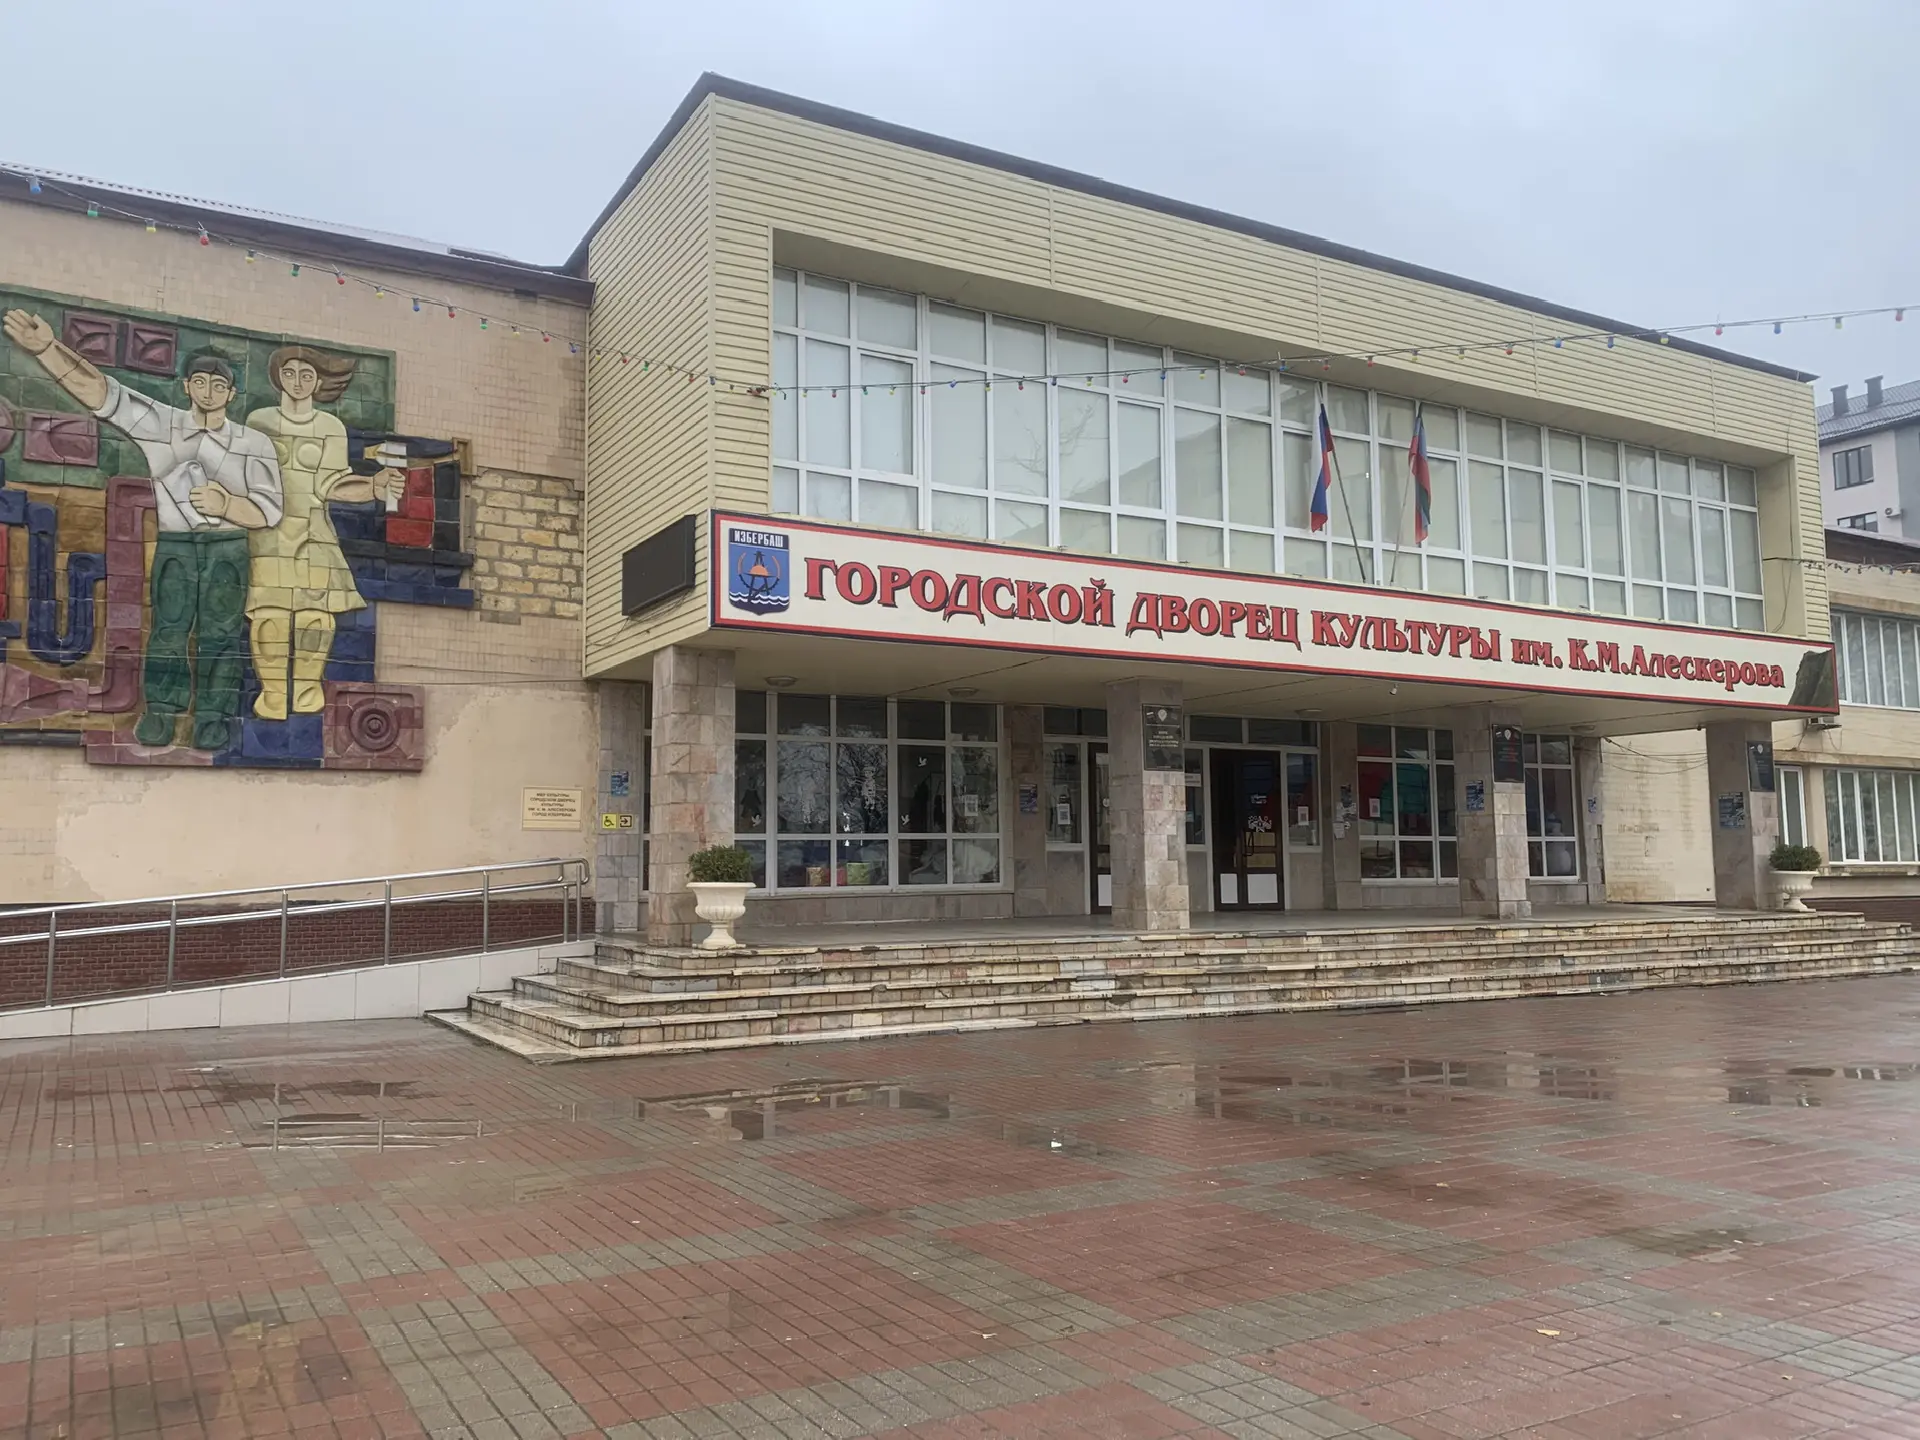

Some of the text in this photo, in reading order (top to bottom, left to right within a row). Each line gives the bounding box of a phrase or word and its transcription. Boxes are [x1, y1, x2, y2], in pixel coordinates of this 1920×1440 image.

[734, 530, 784, 548] ИЗБЕРБАШ
[804, 557, 1116, 627] ГОРОДСКОЙ
[1125, 592, 1302, 652] ДВОРЕЦ
[1310, 610, 1503, 662] КУЛЬТУРЫ
[1511, 638, 1563, 668] им.
